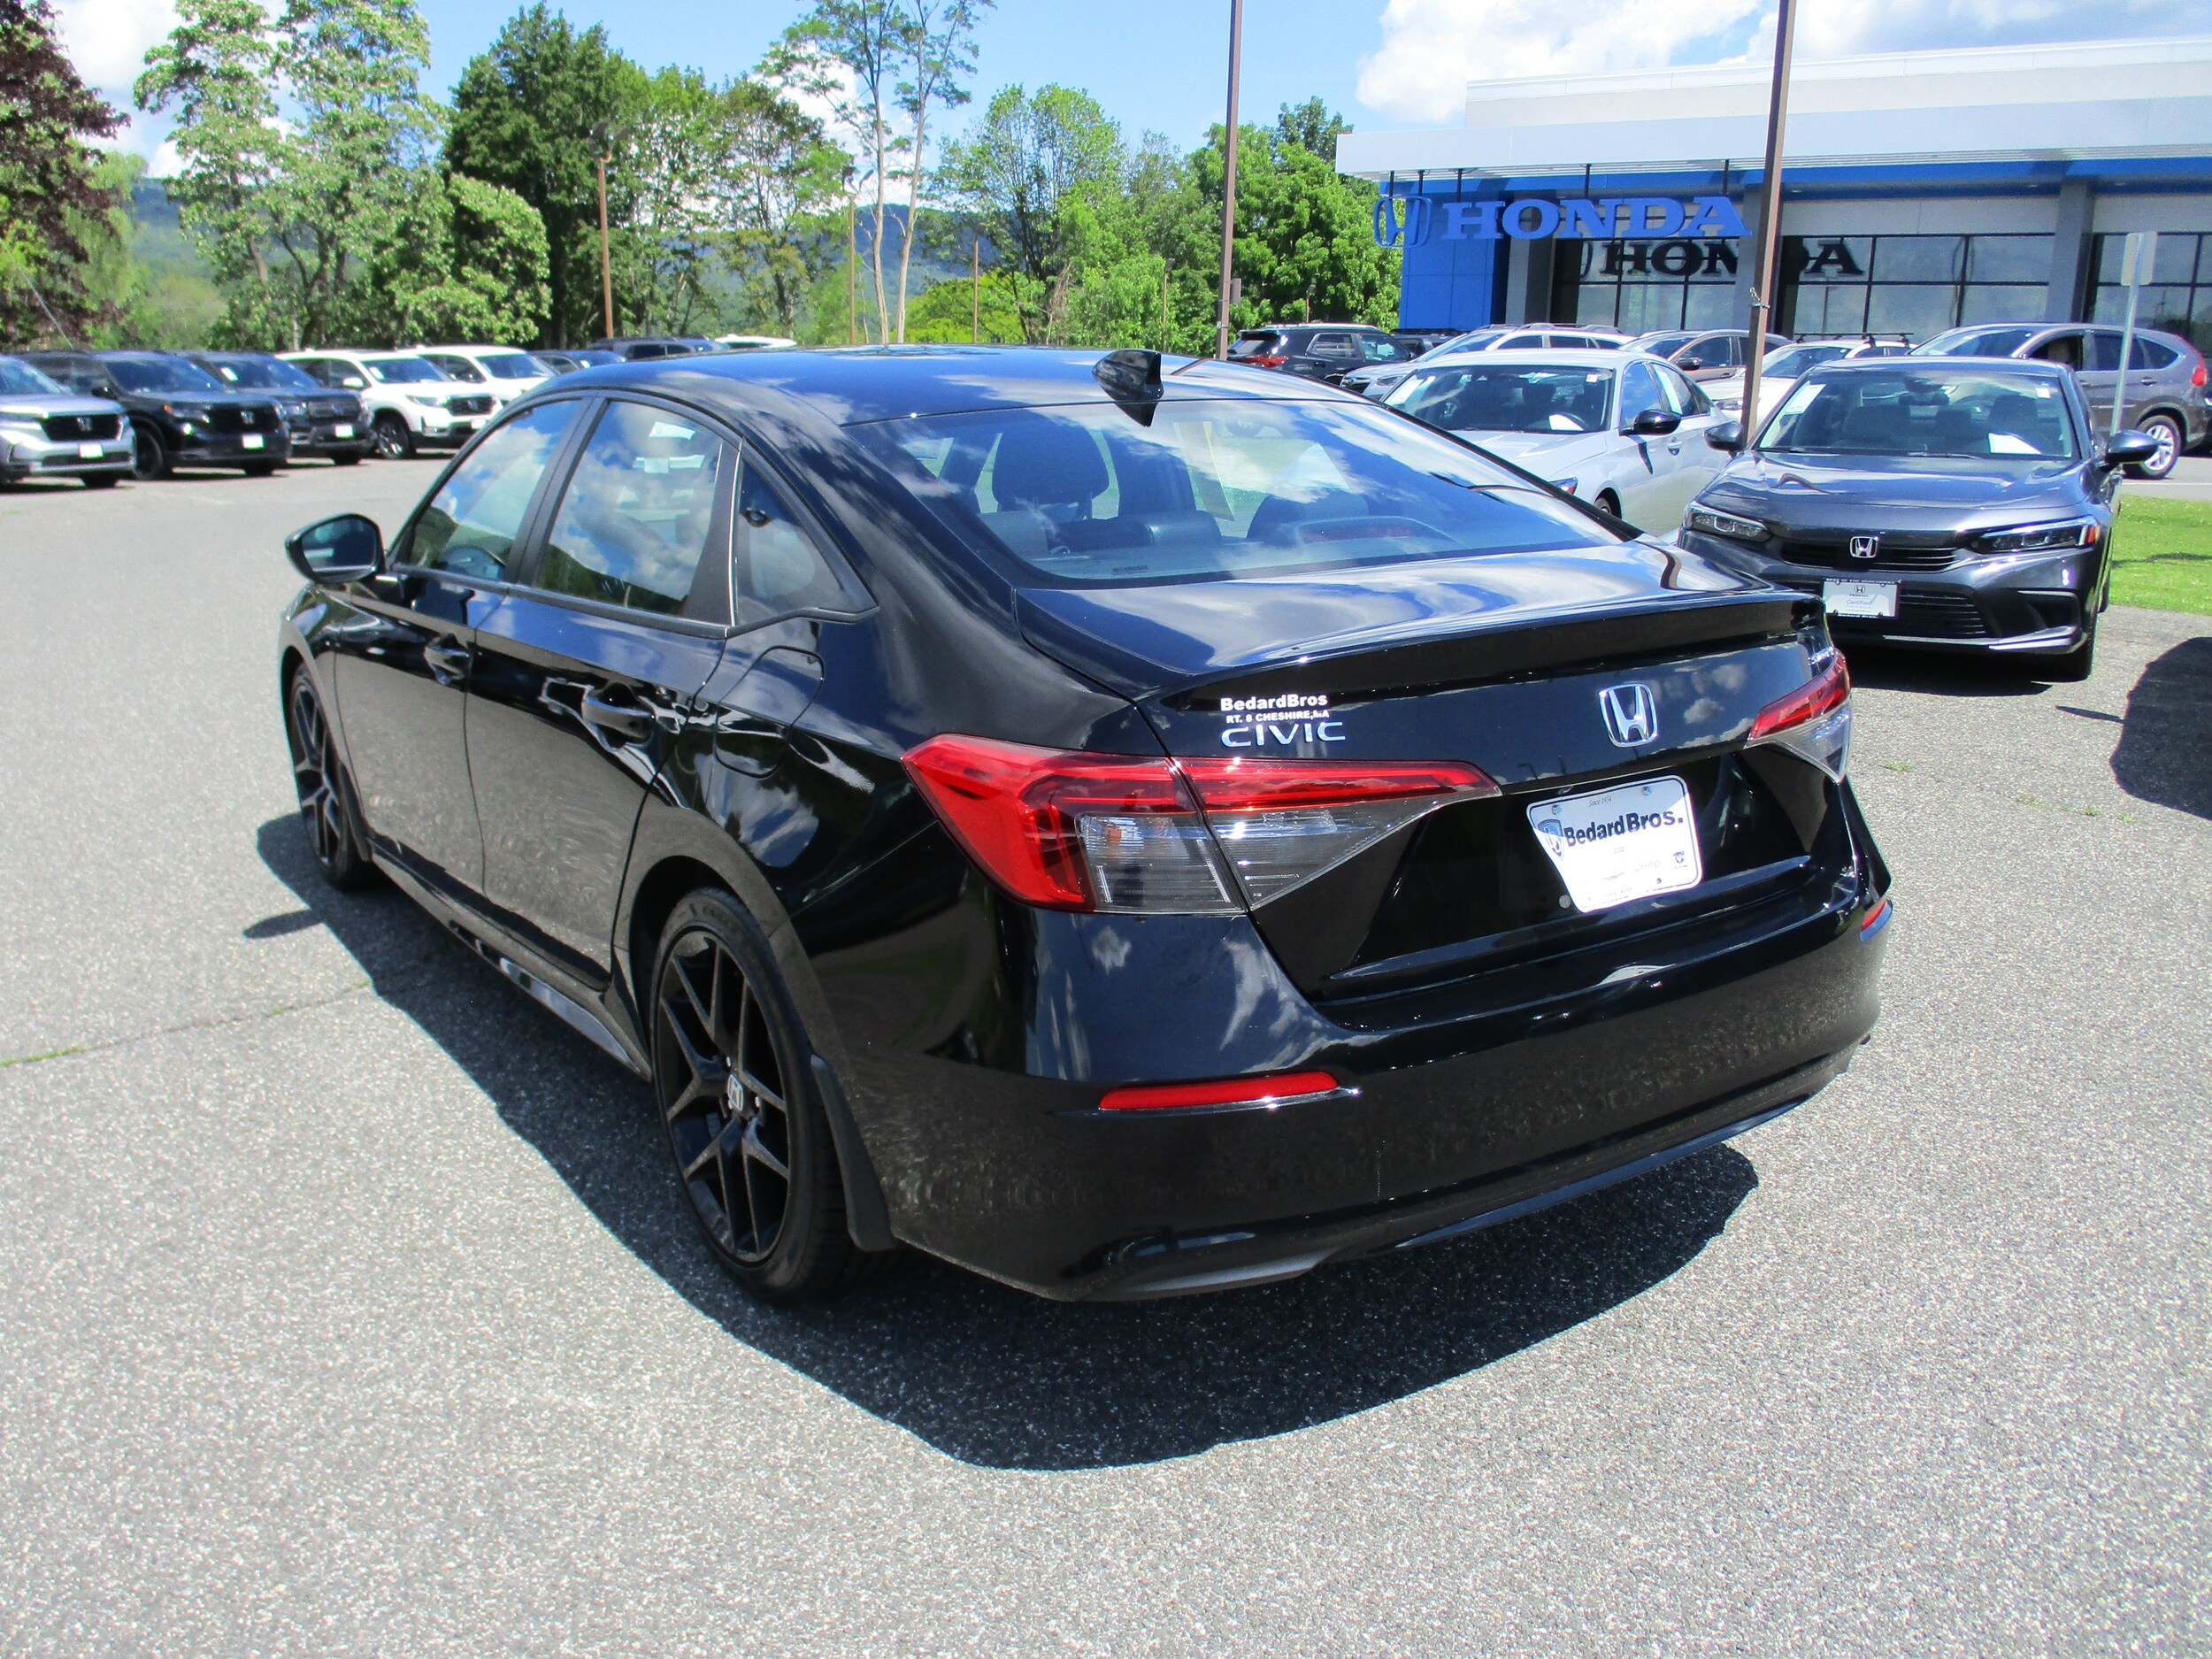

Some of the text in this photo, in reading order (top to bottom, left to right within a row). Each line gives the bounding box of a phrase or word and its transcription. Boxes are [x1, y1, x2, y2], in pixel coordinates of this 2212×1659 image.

[1441, 196, 1753, 240] HONDA
[1225, 714, 1243, 724] RT.
[1245, 713, 1253, 723] 8
[1220, 721, 1346, 748] CIVIC
